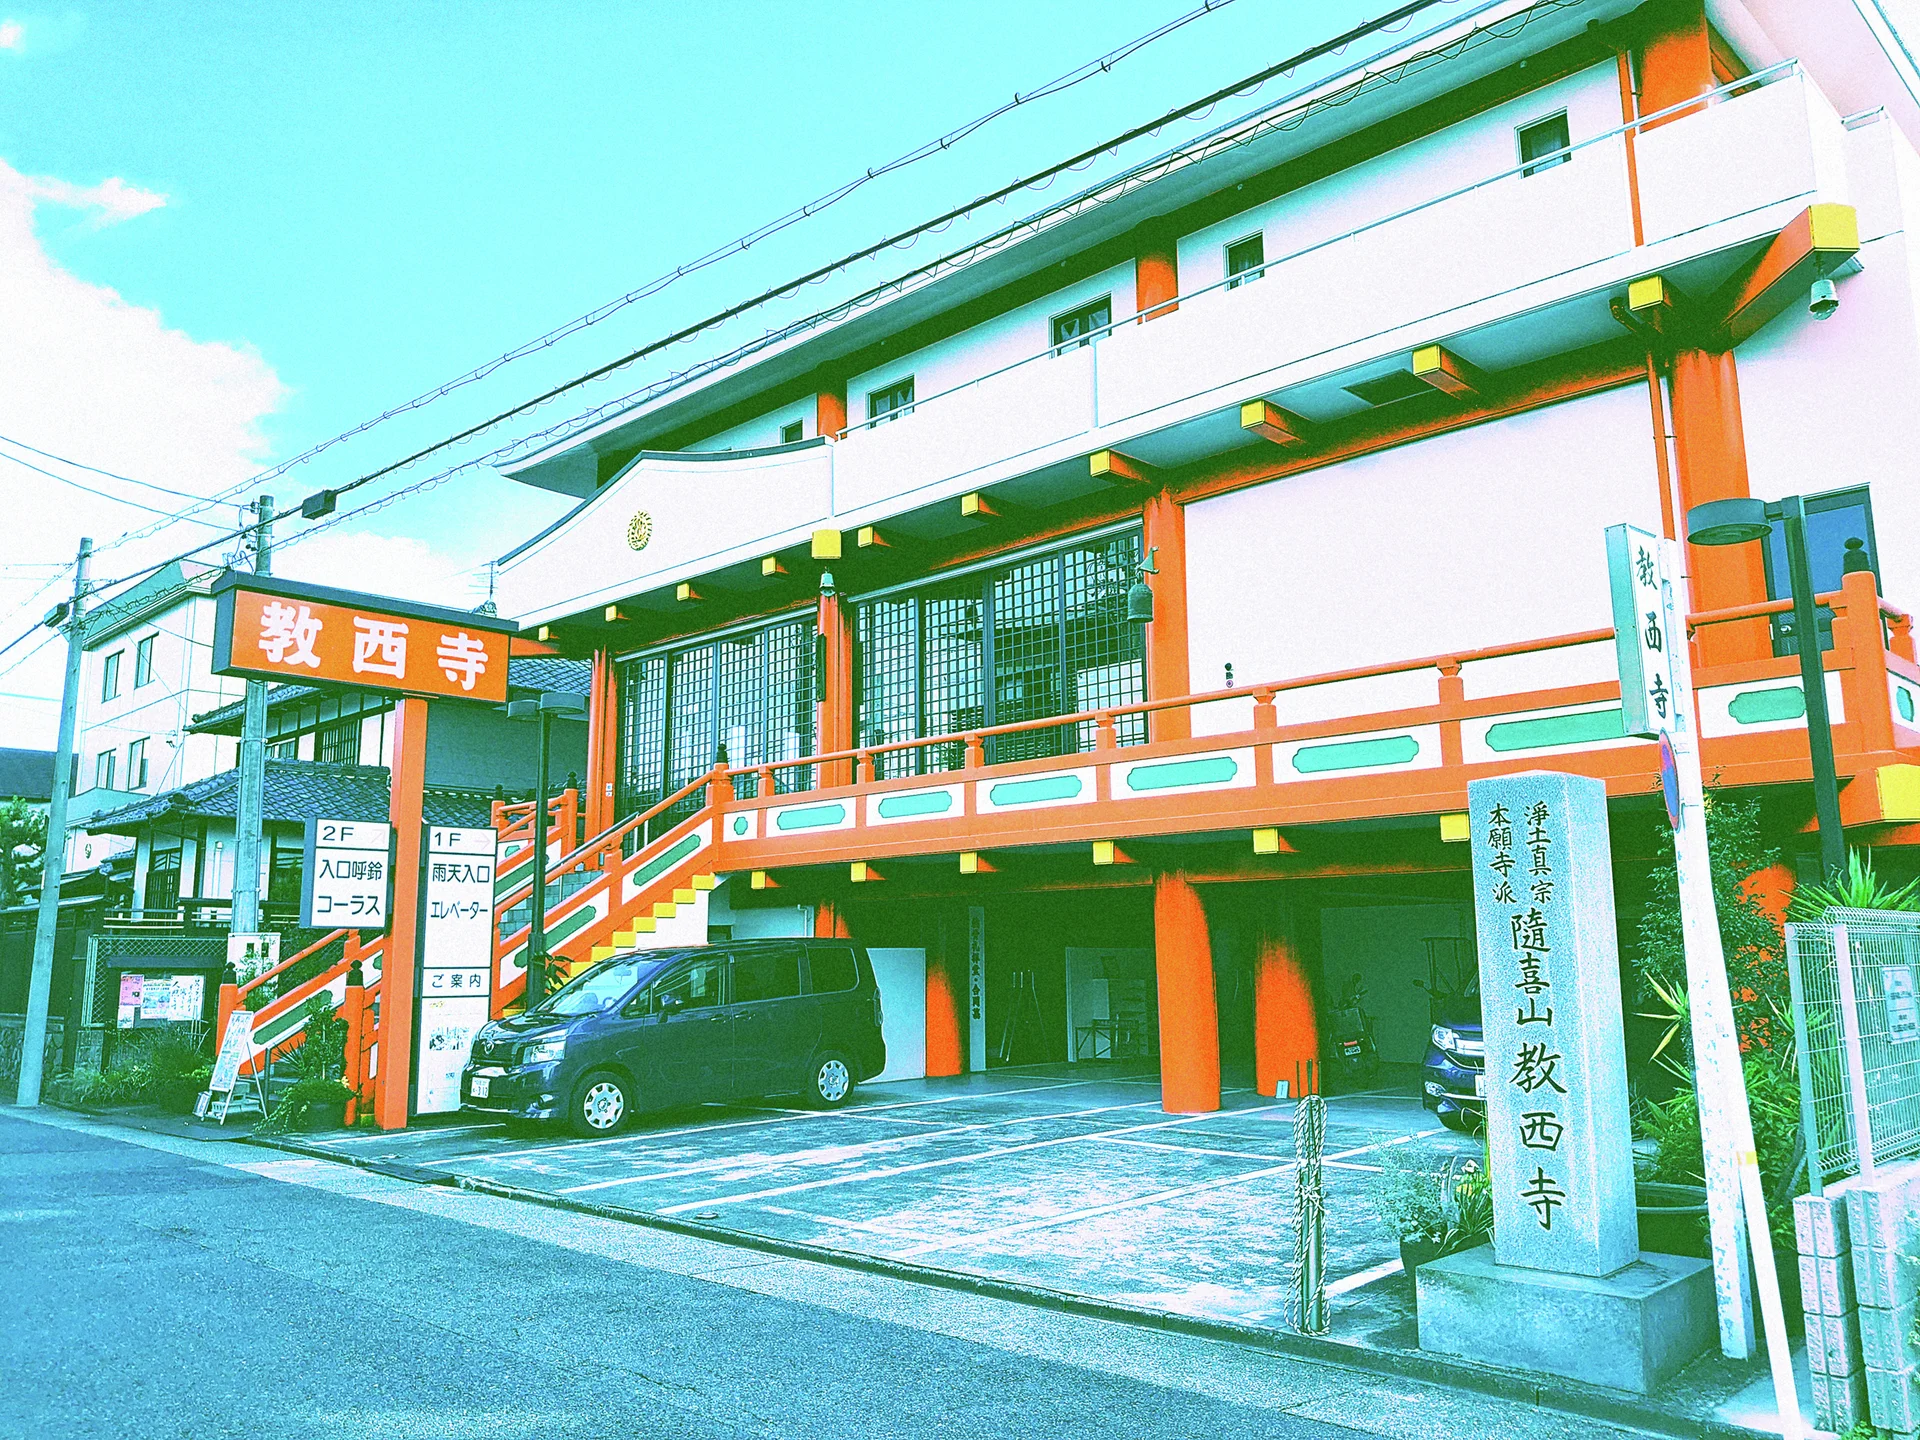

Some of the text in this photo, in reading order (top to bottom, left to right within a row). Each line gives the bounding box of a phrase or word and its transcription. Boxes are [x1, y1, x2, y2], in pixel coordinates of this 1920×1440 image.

[1635, 546, 1669, 719] 教西寺
[258, 601, 488, 690] 教西寺
[322, 825, 354, 842] 2F
[434, 831, 461, 847] 1F
[1488, 802, 1517, 904] 本願寺派
[319, 859, 383, 881] 入口呼鈴
[432, 862, 490, 883] 雨天入口
[317, 895, 381, 916] コーラス
[430, 900, 488, 920] エレベーター
[432, 973, 482, 989] ご案内
